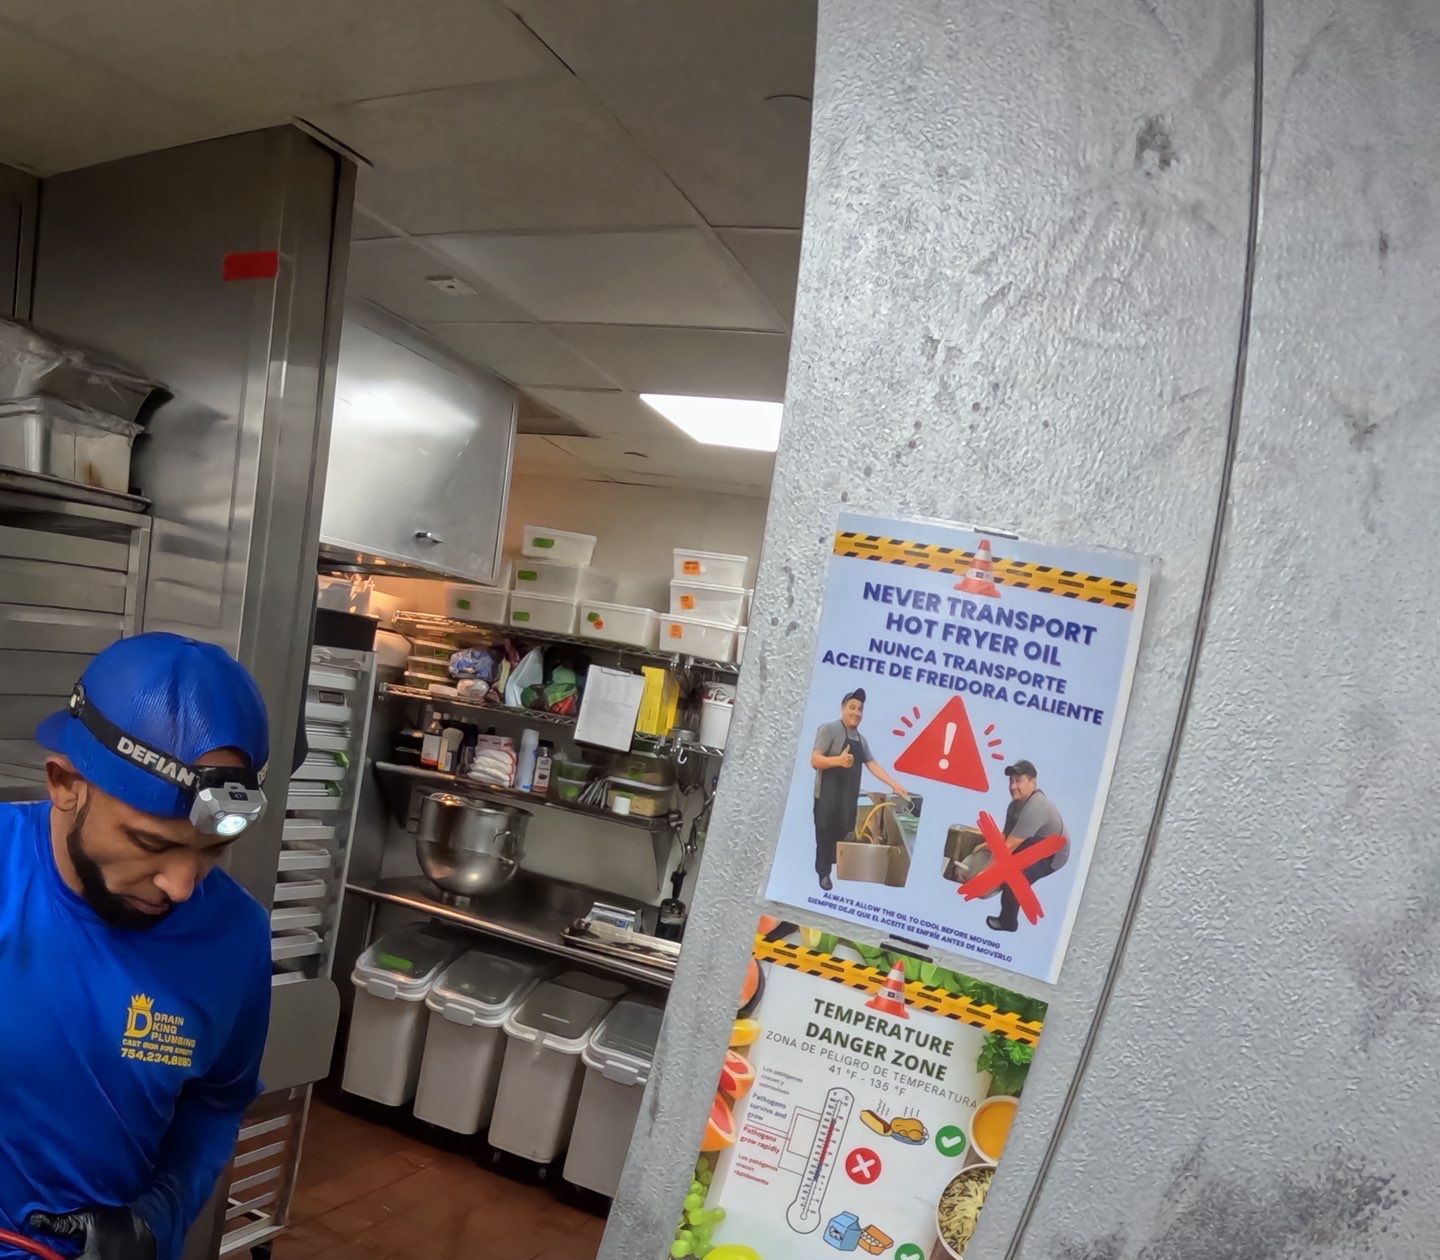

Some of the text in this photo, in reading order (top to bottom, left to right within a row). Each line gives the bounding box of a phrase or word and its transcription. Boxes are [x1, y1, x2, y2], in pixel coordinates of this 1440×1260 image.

[863, 581, 1097, 646] NEVER TRANSPORT
[886, 612, 1062, 666] HOT FRYER OIL
[822, 650, 1104, 725] ACEITE DE FREIDORA CALIENTE
[869, 638, 1067, 694] NUNCA TRANSPORTE
[117, 736, 199, 788] DEFIAN
[807, 896, 838, 910] SIEMPRE
[838, 904, 857, 916] DEJE
[857, 909, 871, 920] QUE
[872, 914, 881, 923] EL
[880, 917, 907, 930] ACEITE
[941, 934, 965, 948] ANTES
[965, 941, 976, 952] DE
[976, 944, 1013, 963] MOVERLO
[822, 892, 1000, 949] ALWAYS ALLOW THE OIL TO COOL BEFORE MOVING
[152, 1022, 177, 1034] KING
[154, 1012, 184, 1026] DRAIN
[813, 998, 955, 1057] TEMPERATURE
[766, 1030, 978, 1110] ZONA DE PELIGRO DE TEMPERATURA
[805, 1021, 948, 1082] DANGER ZONE
[828, 1064, 842, 1075] 41
[870, 1078, 889, 1092] 135
[747, 1112, 764, 1121] grow
[749, 1103, 787, 1119] survive and
[752, 1092, 787, 1110] Pathogens
[739, 1135, 781, 1155] grow rapidly
[743, 1125, 777, 1143] Pathogens
